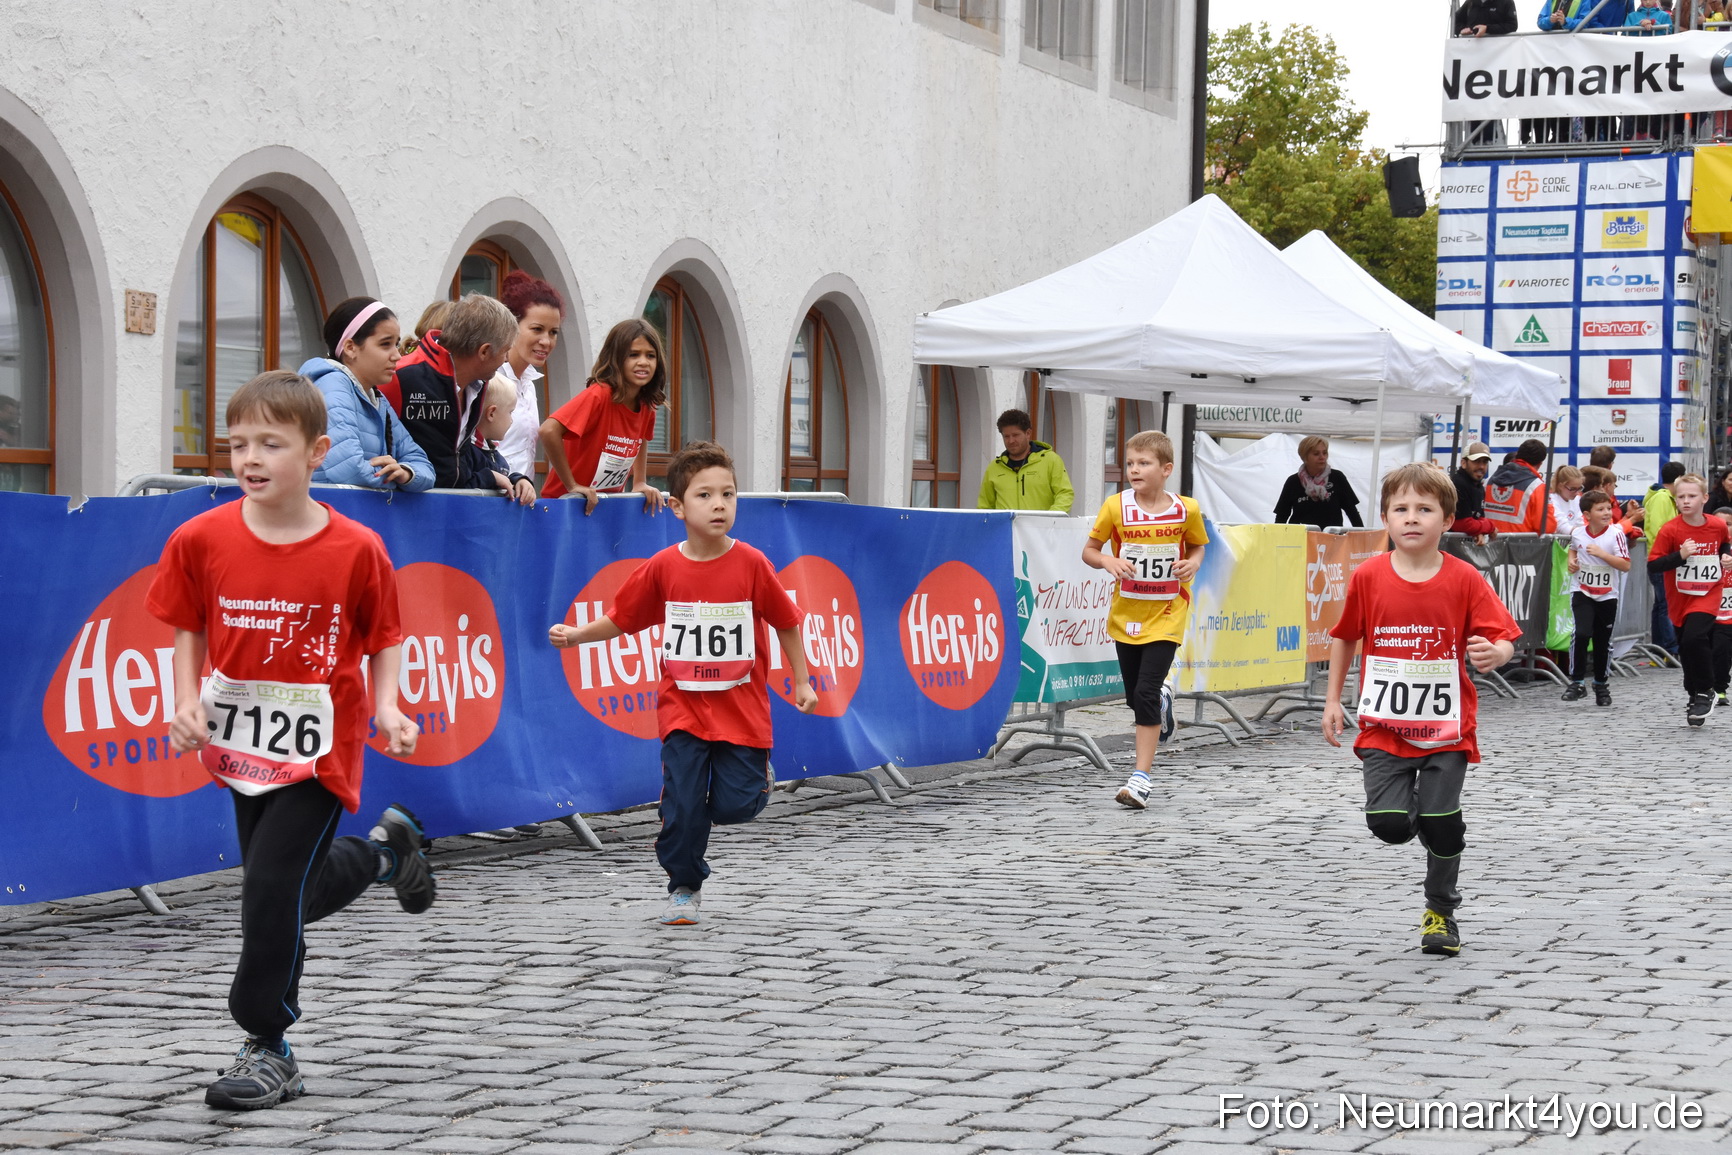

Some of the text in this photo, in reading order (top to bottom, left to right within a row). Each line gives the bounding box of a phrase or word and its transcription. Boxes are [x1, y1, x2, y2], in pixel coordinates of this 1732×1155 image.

[1443, 51, 1684, 100] Neumarkt
[1542, 177, 1567, 185] CODE
[1589, 182, 1642, 191] RAIL.ONE
[1542, 185, 1570, 193] CLINIC
[1504, 226, 1566, 236] Neumarkter Tagblatt
[1606, 222, 1645, 235] Burgis
[1517, 278, 1570, 287] VARIOTEC
[405, 405, 450, 420] CAMP
[1494, 419, 1541, 432] swn
[1123, 526, 1184, 539] MAX BÖGL
[1126, 556, 1176, 579] 7157
[1682, 565, 1718, 580] 7142
[1580, 570, 1611, 586] 7019
[1132, 583, 1167, 593] Andreas
[219, 595, 304, 613] Neumarkter
[699, 606, 746, 617] BOCK
[222, 612, 285, 633] Stadtlauf
[1374, 624, 1434, 636] Neumarkter
[671, 623, 743, 657] 7161
[907, 593, 999, 680] Hervis
[1374, 637, 1422, 649] Stadtlauf
[65, 617, 176, 733] Her
[398, 613, 497, 724] ervis
[694, 666, 720, 679] Finn
[1372, 666, 1399, 675] NeuerMarkt
[1404, 662, 1452, 675] BOCK
[921, 670, 966, 688] SPORTS
[256, 684, 323, 704] BOCK
[1374, 679, 1452, 716] 7075
[213, 701, 322, 758] 7126
[368, 711, 447, 739] SRTS
[87, 735, 182, 769] SPORT
